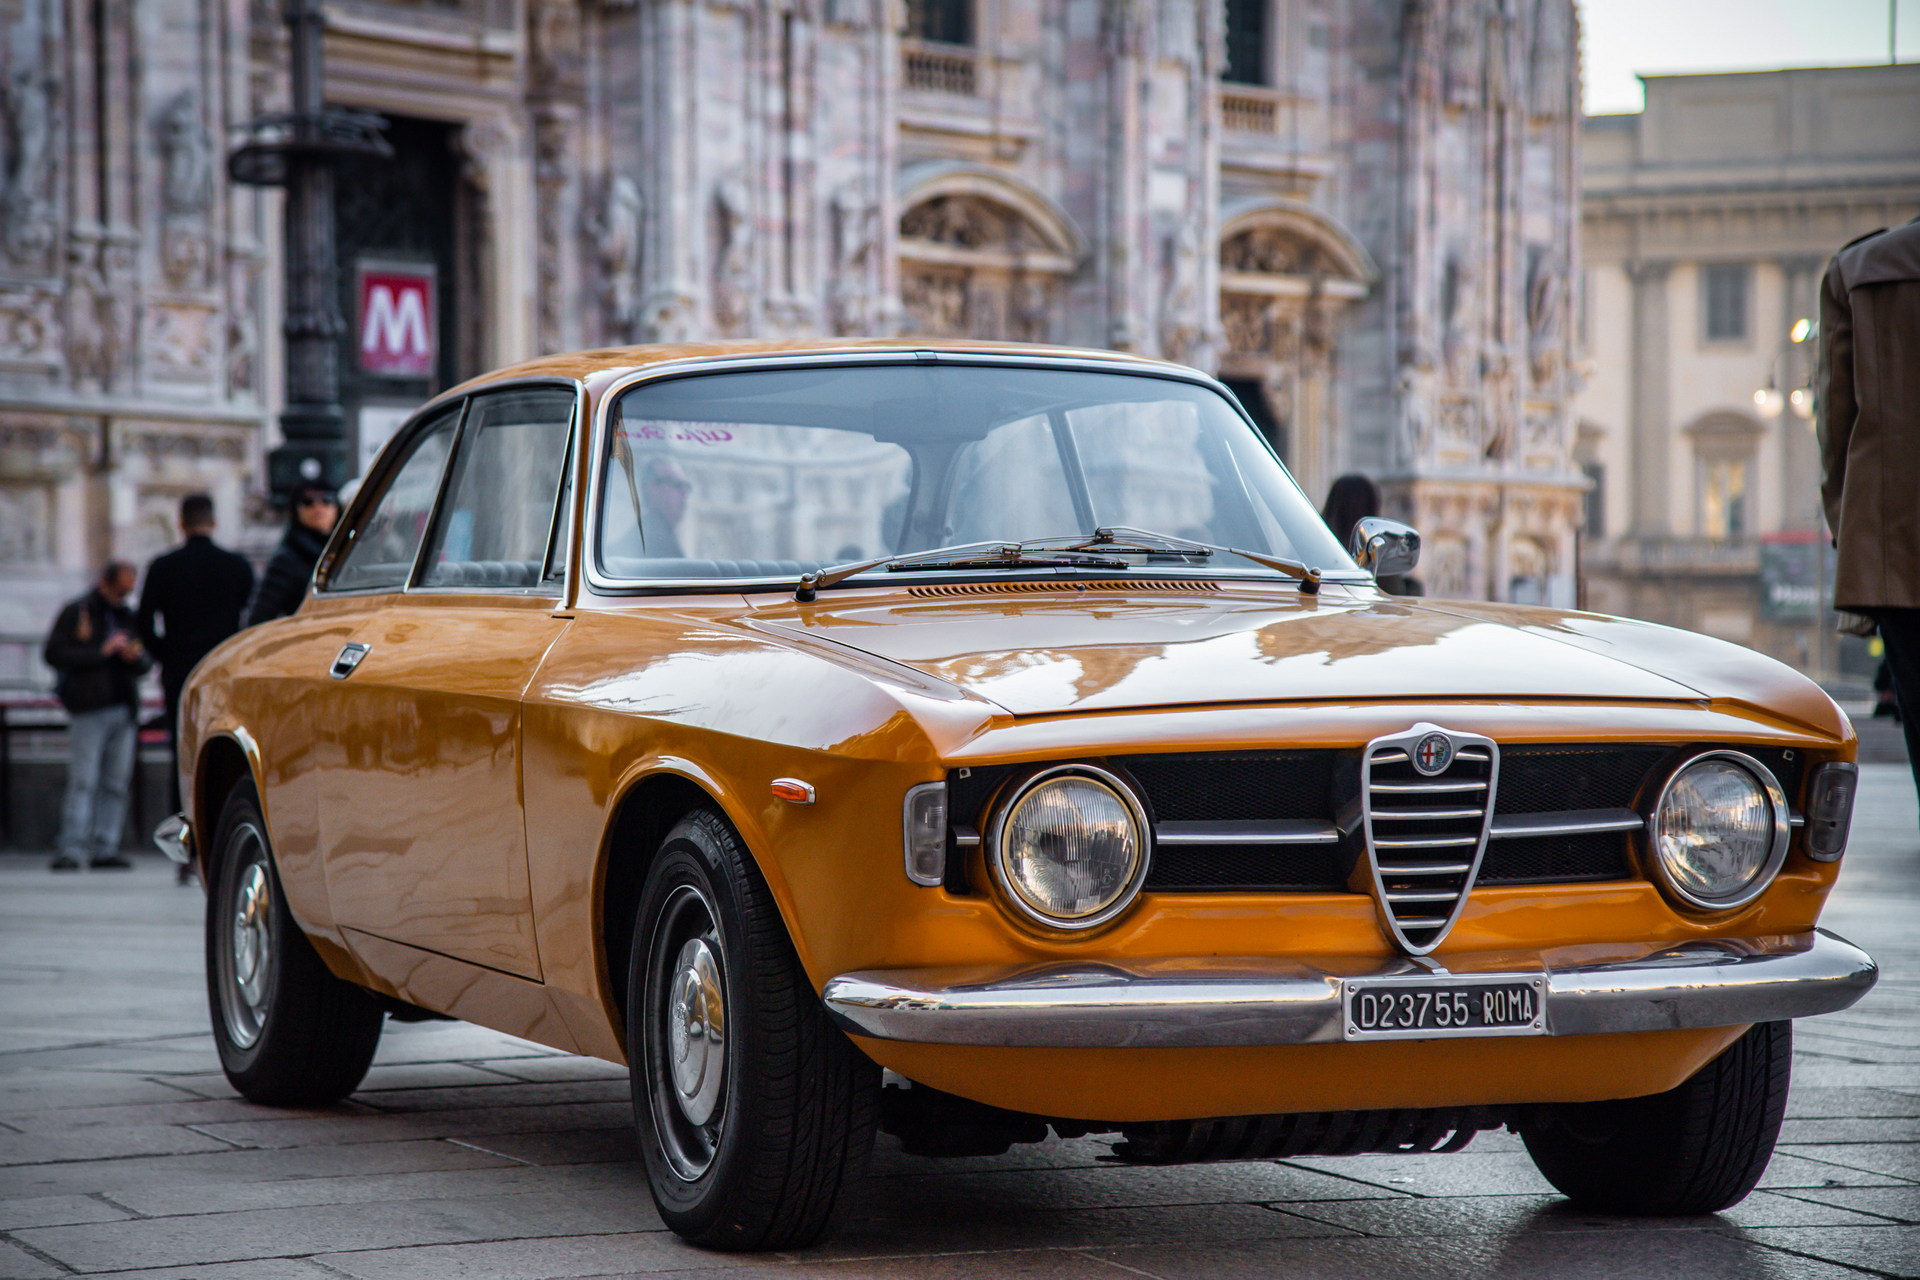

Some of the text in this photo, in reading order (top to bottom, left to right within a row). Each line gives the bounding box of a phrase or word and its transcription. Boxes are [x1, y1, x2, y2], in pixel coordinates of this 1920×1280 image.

[362, 285, 427, 354] M
[1360, 989, 1533, 1028] D23755 ROMA
